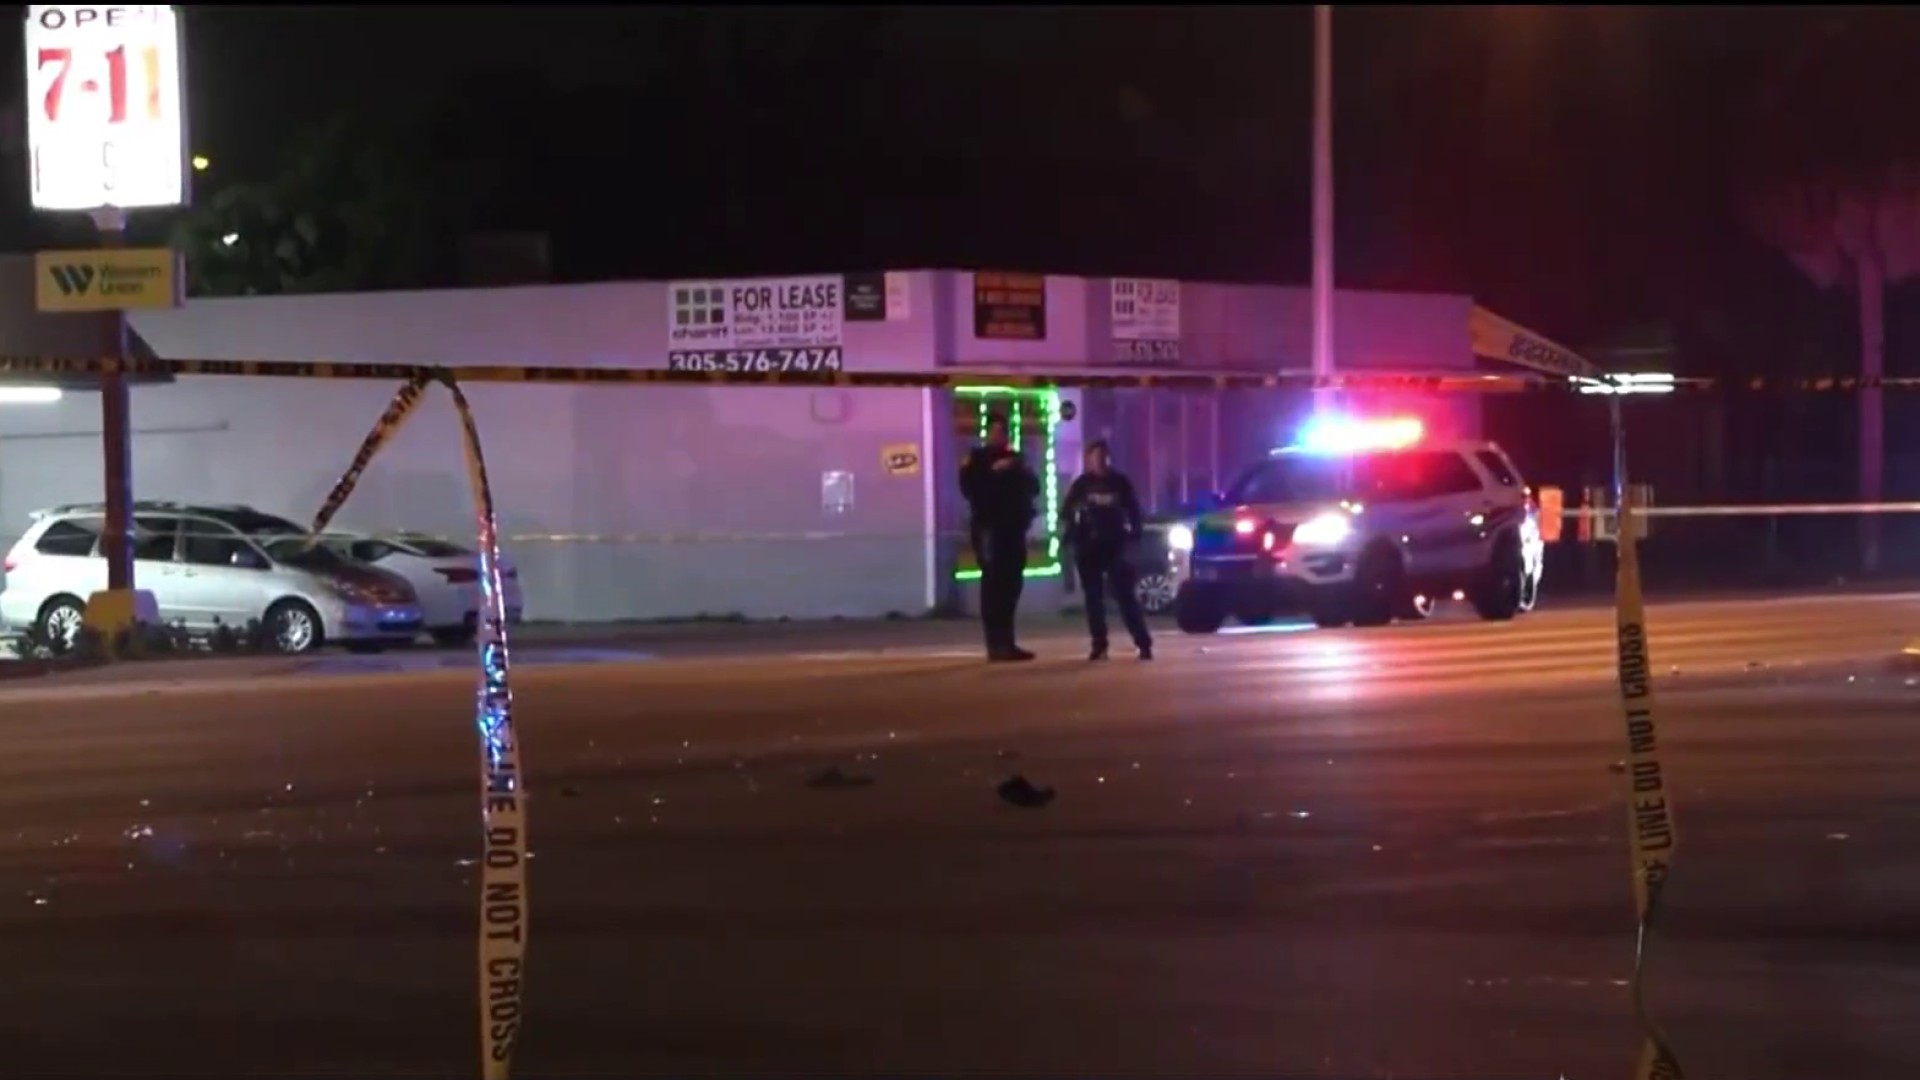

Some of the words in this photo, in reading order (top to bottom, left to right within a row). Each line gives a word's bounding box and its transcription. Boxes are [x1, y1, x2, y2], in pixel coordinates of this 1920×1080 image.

[37, 44, 160, 124] 7-11
[732, 287, 772, 311] FOR
[778, 283, 837, 309] LEASE
[672, 350, 840, 372] 305-576-7474
[1618, 622, 1649, 700] CROSS
[1626, 708, 1657, 754] NOT
[1632, 760, 1663, 793] DO
[487, 827, 519, 869] DO
[1635, 797, 1672, 851] LINE
[486, 883, 521, 944] NOT
[487, 957, 521, 1063] CROSS
